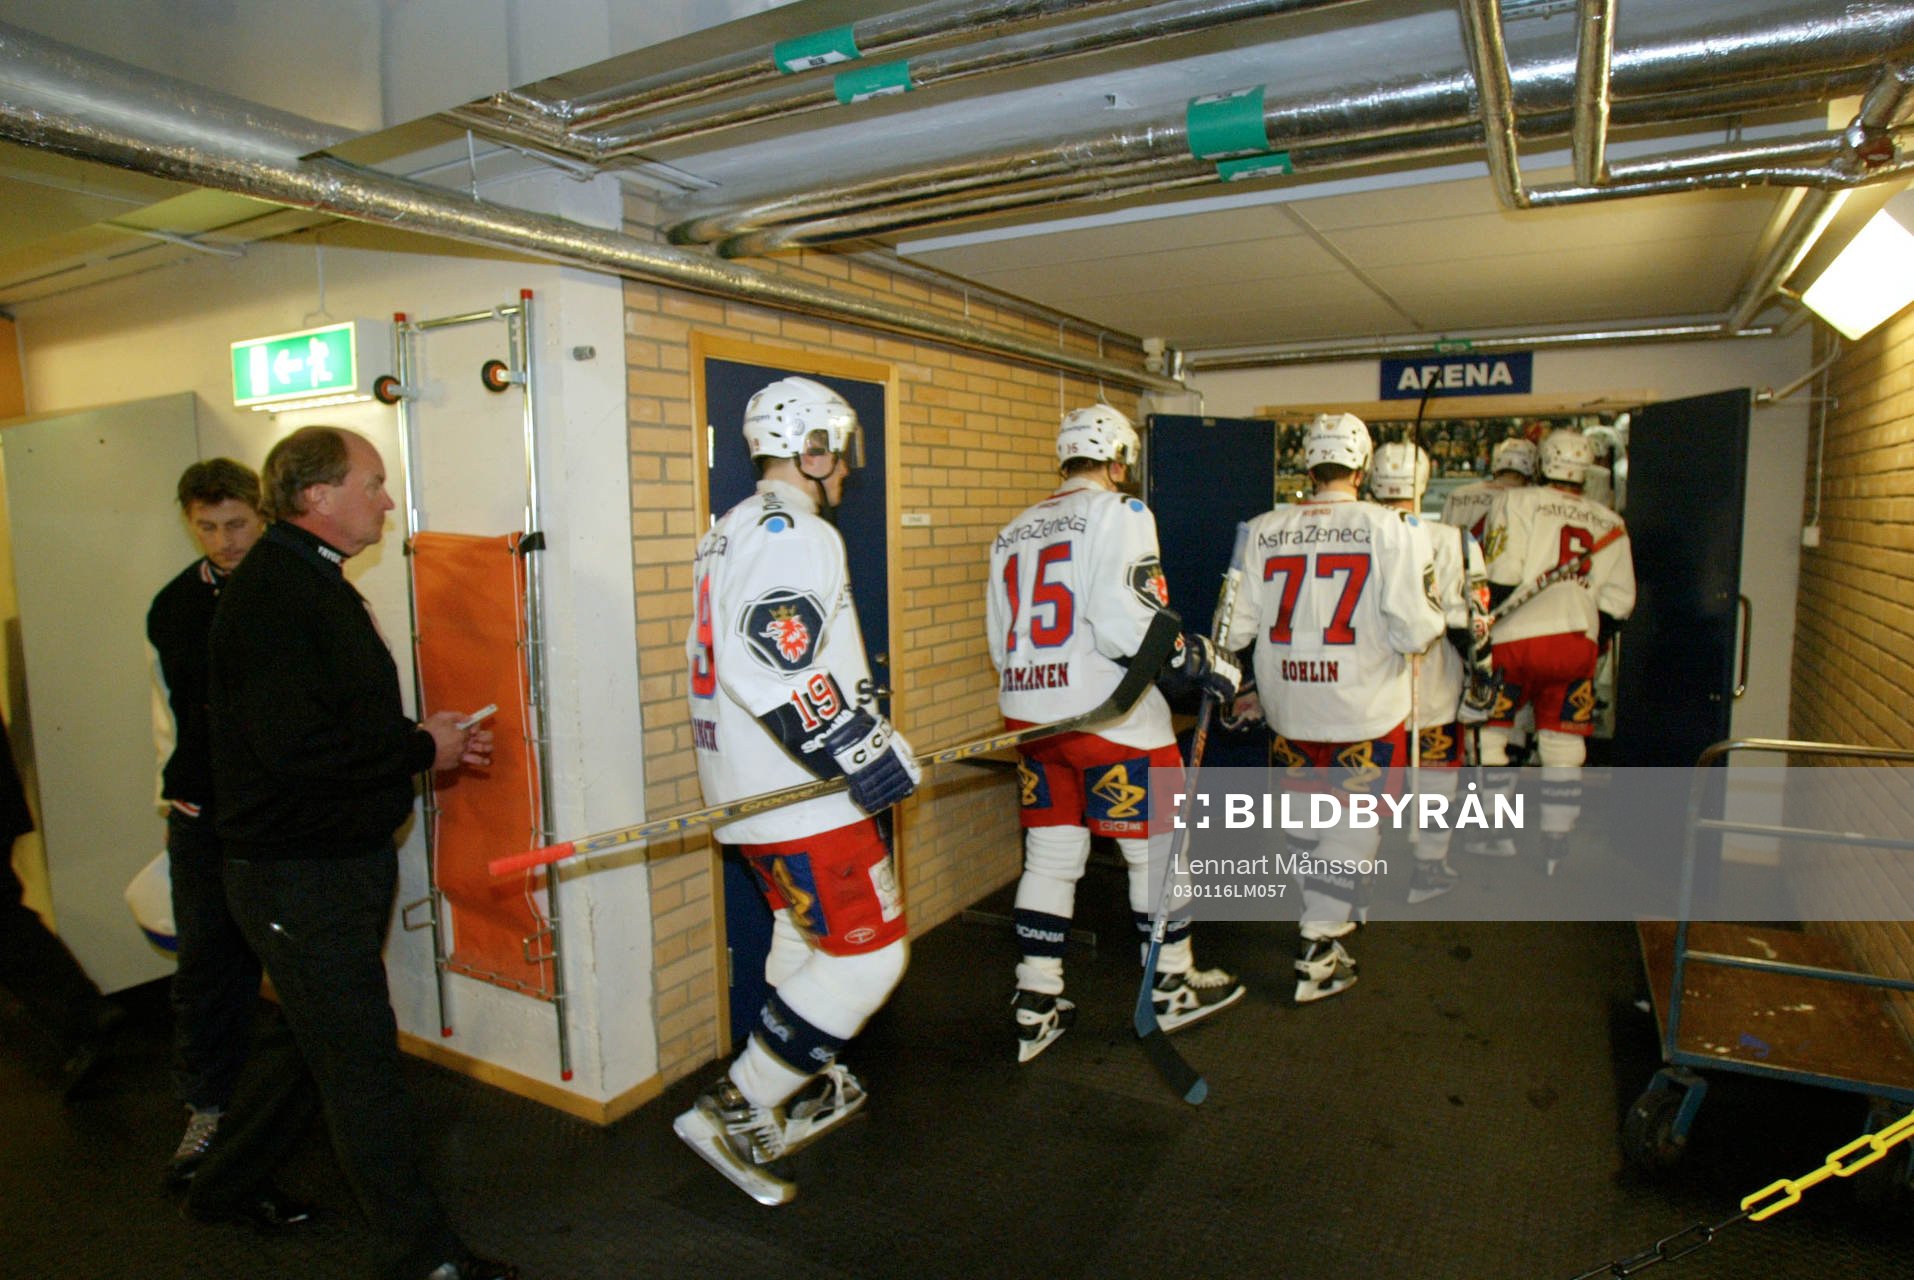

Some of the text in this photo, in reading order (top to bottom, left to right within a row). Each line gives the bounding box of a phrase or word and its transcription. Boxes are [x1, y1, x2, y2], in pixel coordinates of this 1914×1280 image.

[1397, 360, 1514, 391] ARENA
[995, 513, 1088, 555] AstraZeneca
[1258, 525, 1372, 549] AstraZeneca
[1003, 540, 1075, 653] 15
[1263, 552, 1372, 646] 77
[790, 672, 841, 734] 19
[575, 807, 729, 853] CCM
[1100, 820, 1143, 833] CCM
